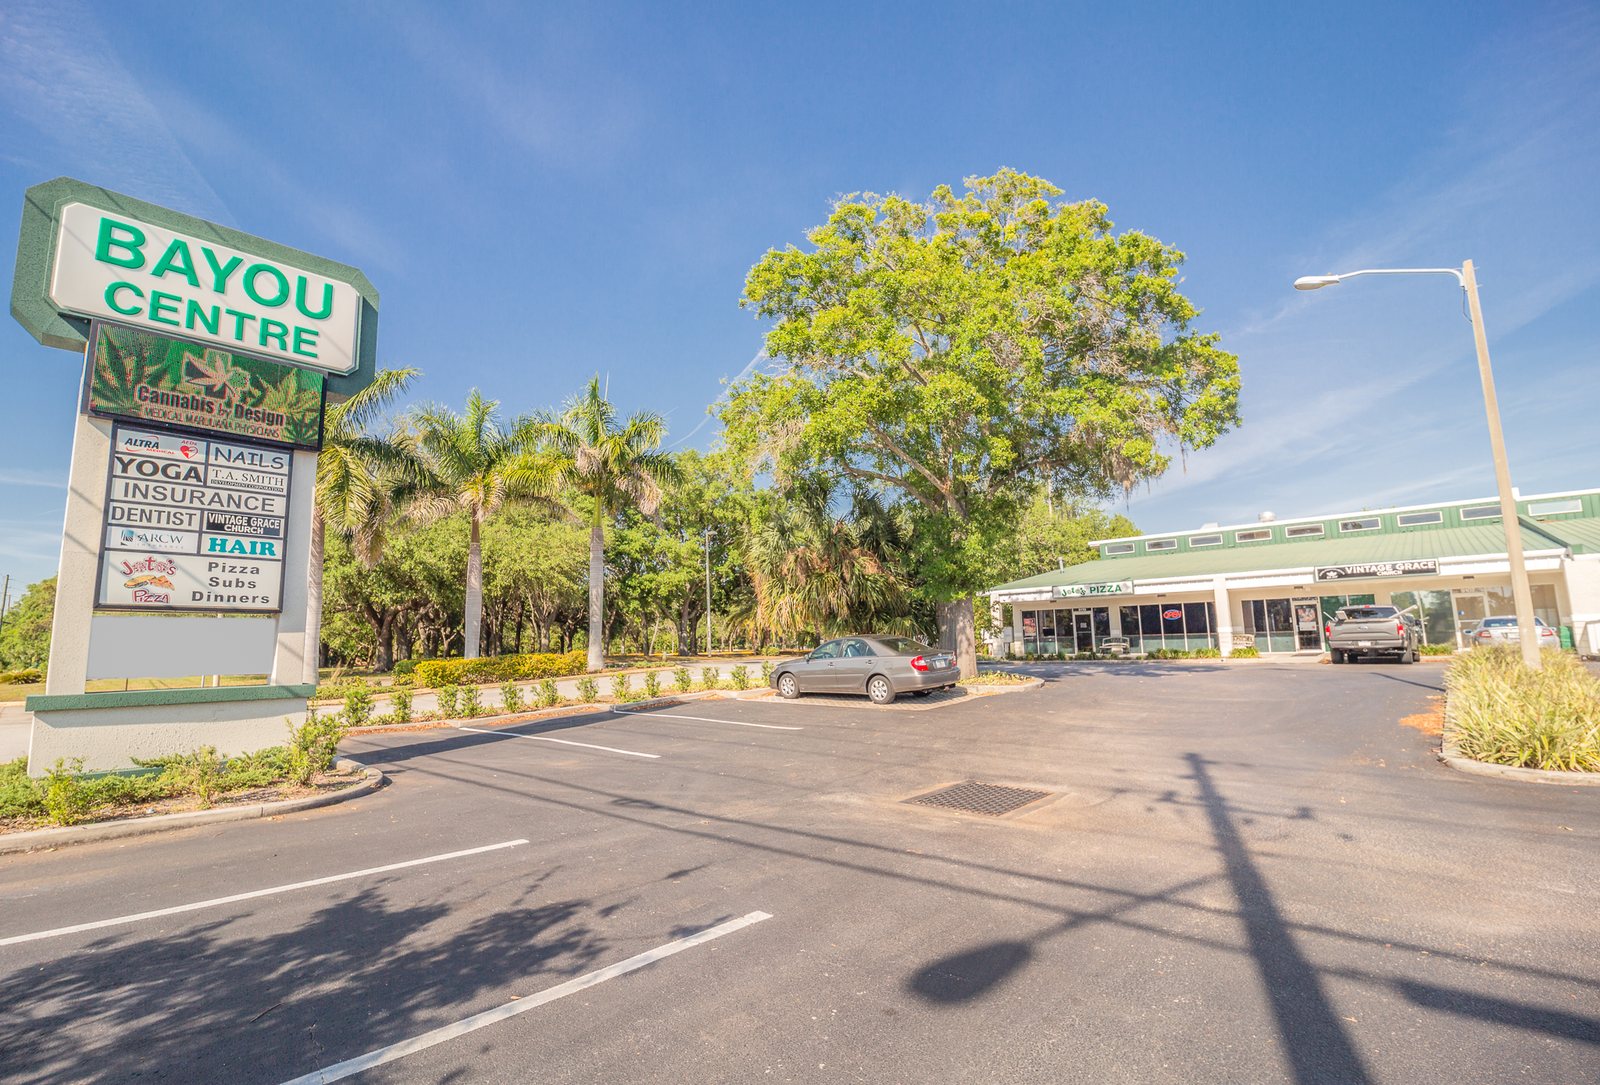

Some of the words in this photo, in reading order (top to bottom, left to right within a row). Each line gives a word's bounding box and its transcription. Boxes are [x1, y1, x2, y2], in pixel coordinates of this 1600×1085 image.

[95, 217, 333, 320] BAYOU
[104, 281, 320, 359] CENTRE
[138, 385, 215, 414] Cannabis
[218, 403, 232, 419] by
[234, 403, 285, 426] Design
[144, 407, 183, 422] MEDICAL
[234, 421, 280, 438] PHYSICIANS
[125, 437, 159, 449] ALTRA
[214, 446, 284, 469] NAILS
[115, 456, 203, 483] YOGA
[212, 469, 238, 481] T.A.
[241, 473, 284, 487] SMITH
[123, 482, 275, 513] INSURANCE
[111, 505, 197, 527] DENTIST
[207, 513, 248, 526] VINTAGE
[250, 517, 280, 529] GRACE
[224, 524, 264, 535] CHURCH
[207, 537, 276, 557] HAIR
[207, 561, 260, 575] Pizza
[1344, 563, 1393, 574] VINTAGE
[1396, 561, 1436, 571] GRACE
[1376, 569, 1403, 577] CHURCH
[208, 576, 257, 589] Subs
[1089, 584, 1122, 594] PIZZA
[191, 591, 270, 604] Dinners
